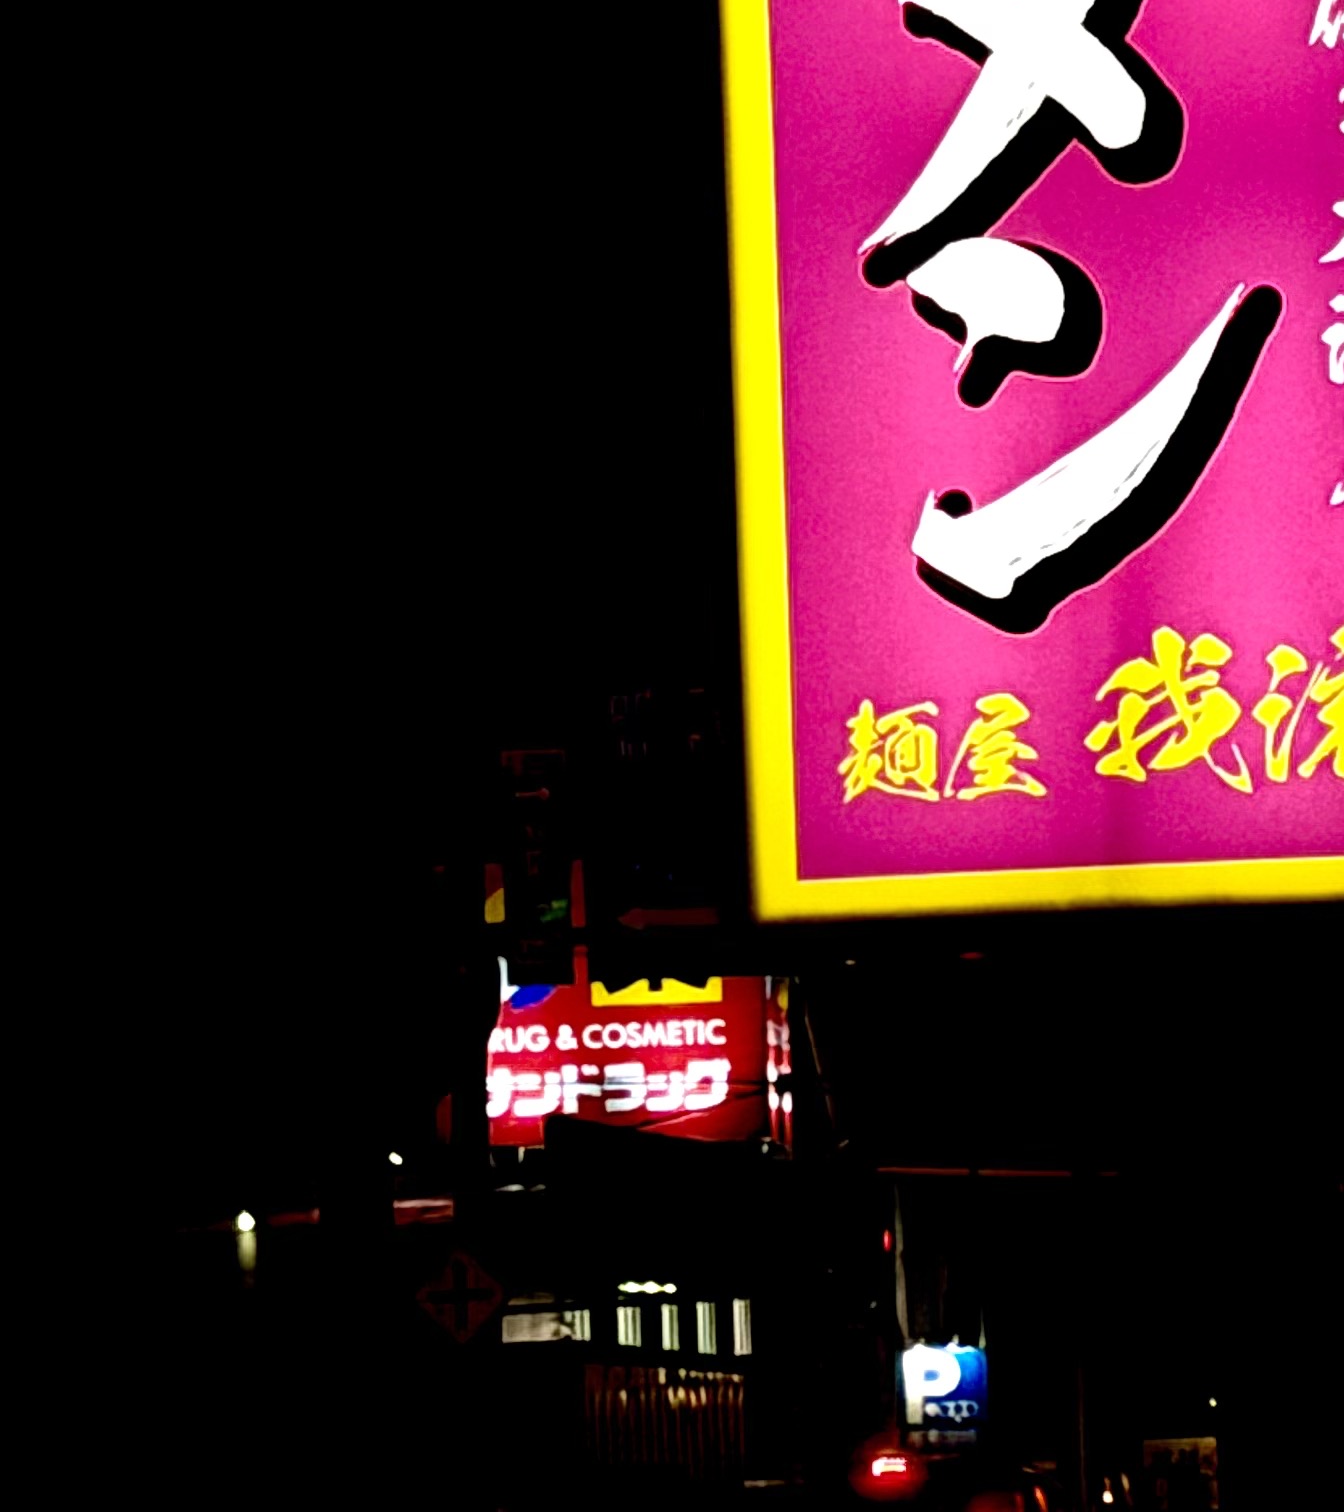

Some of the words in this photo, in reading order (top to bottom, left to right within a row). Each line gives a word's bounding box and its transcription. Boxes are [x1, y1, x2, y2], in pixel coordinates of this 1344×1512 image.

[836, 691, 1049, 804] 麺屋
[555, 1024, 579, 1052] &
[582, 1018, 728, 1050] COSMETIC
[902, 1344, 962, 1425] P
